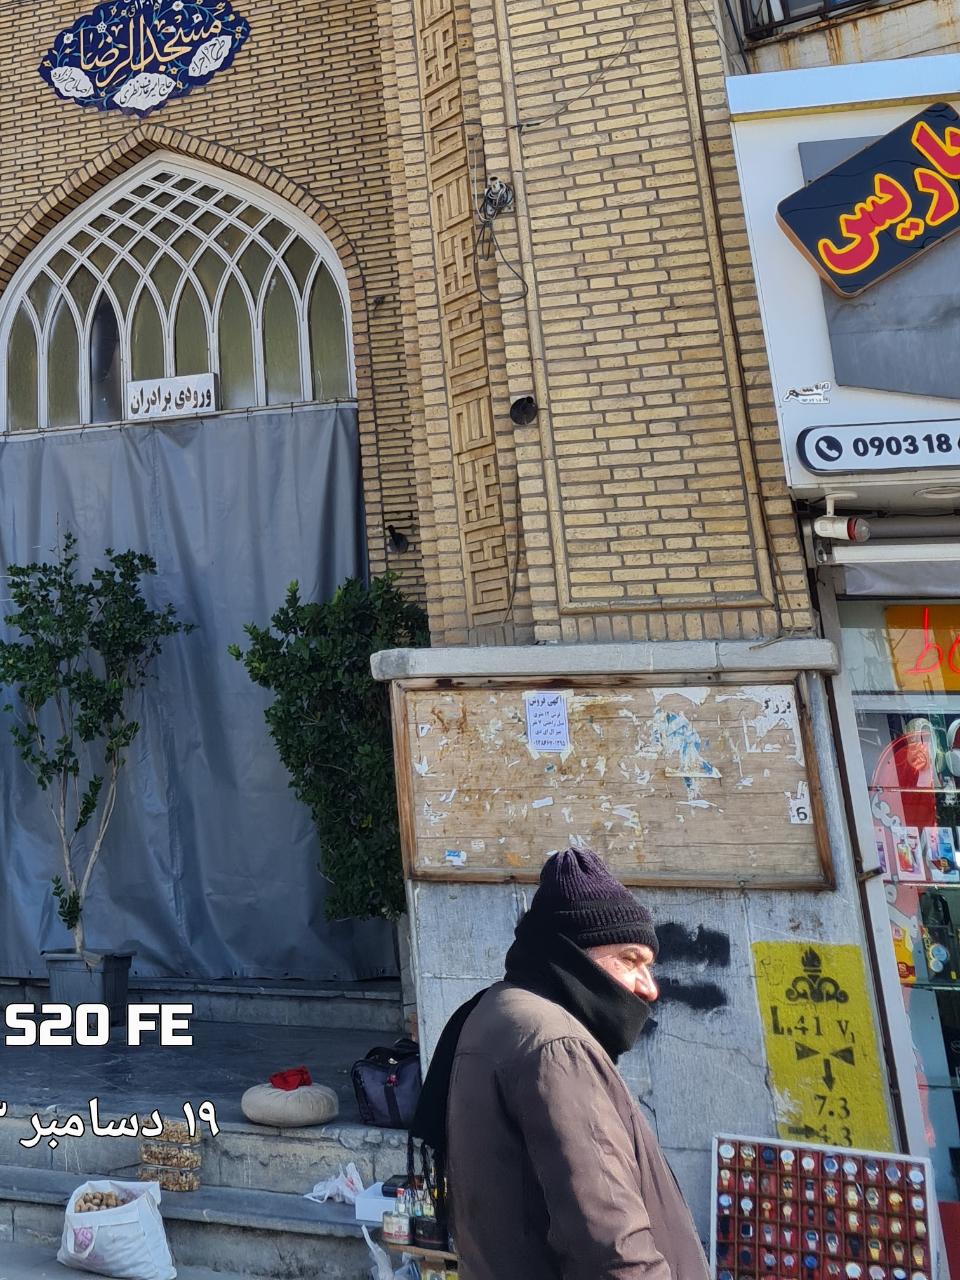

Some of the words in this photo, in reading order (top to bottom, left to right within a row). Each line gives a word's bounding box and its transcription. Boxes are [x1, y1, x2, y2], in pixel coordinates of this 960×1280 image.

[130, 384, 172, 415] برادران
[174, 385, 213, 410] ورودی
[852, 434, 919, 457] 0903
[922, 433, 953, 454] 18
[813, 1094, 851, 1120] 7.3
